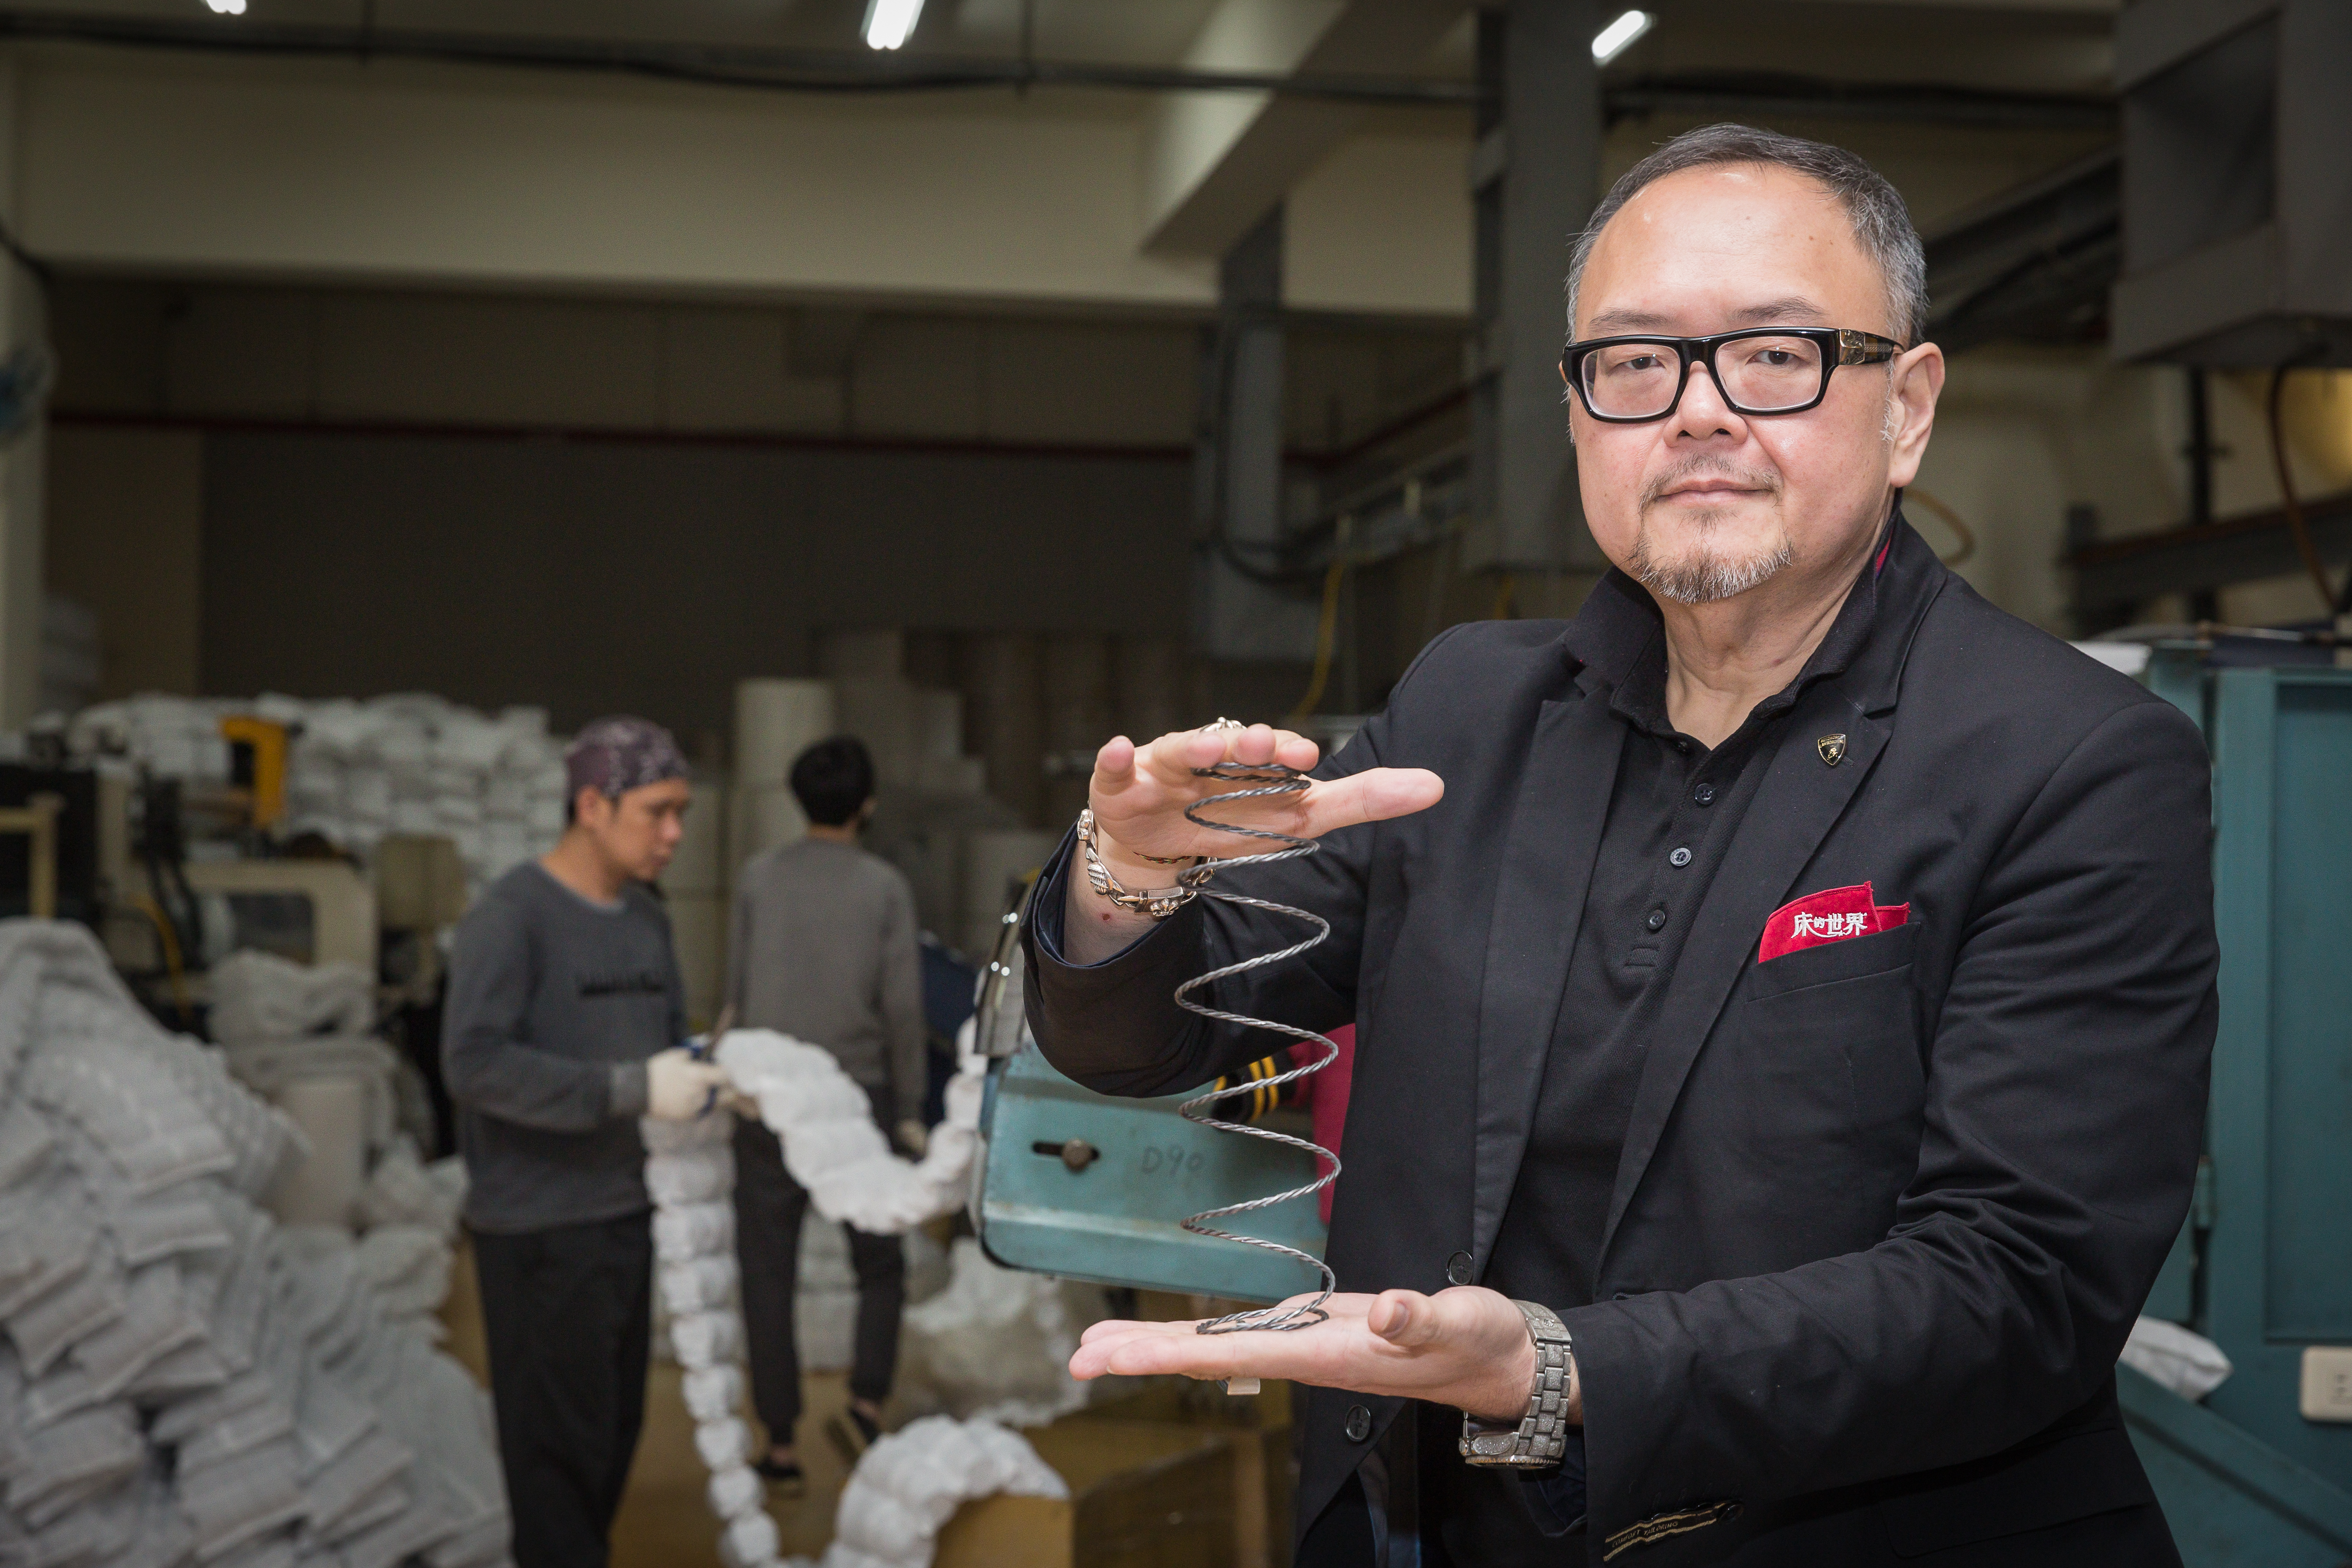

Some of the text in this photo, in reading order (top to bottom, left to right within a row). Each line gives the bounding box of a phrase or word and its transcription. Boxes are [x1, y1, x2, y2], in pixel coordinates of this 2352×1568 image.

[1791, 911, 1868, 938] 床的世界
[1612, 1521, 1679, 1548] COMFORT TAILORING
